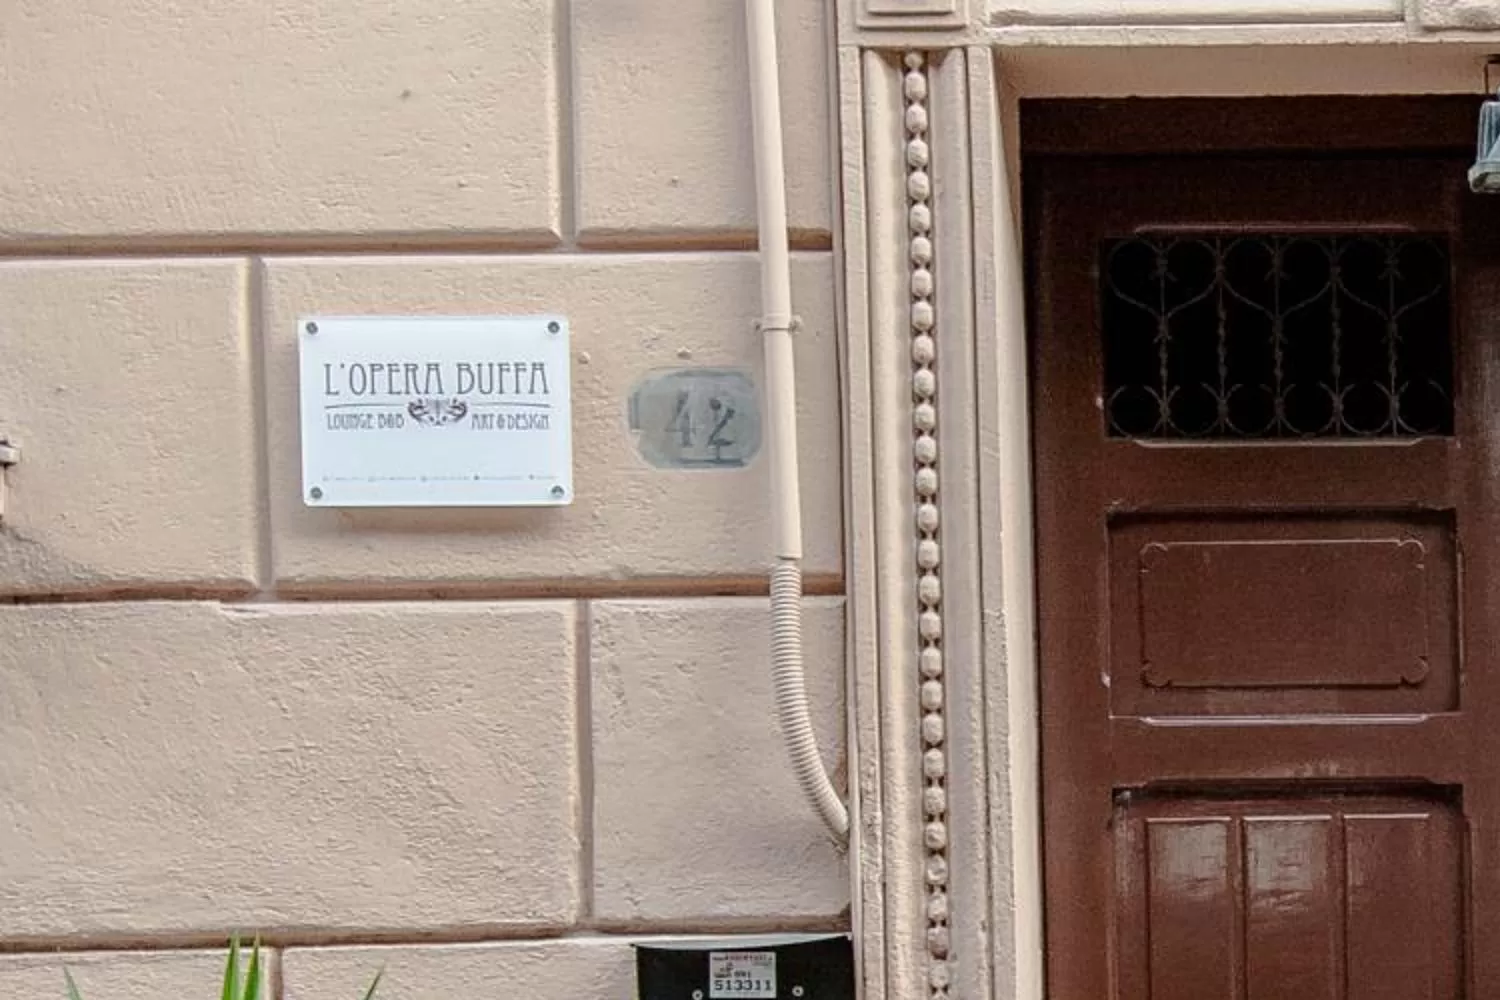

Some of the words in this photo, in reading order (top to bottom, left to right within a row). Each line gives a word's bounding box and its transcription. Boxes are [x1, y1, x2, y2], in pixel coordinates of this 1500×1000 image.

[323, 362, 445, 396] L'OPERA
[456, 362, 550, 395] BUFFA
[326, 413, 374, 430] LOUNGE
[471, 413, 494, 430] ART
[507, 413, 550, 430] DESIGN
[713, 979, 772, 991] 513311
